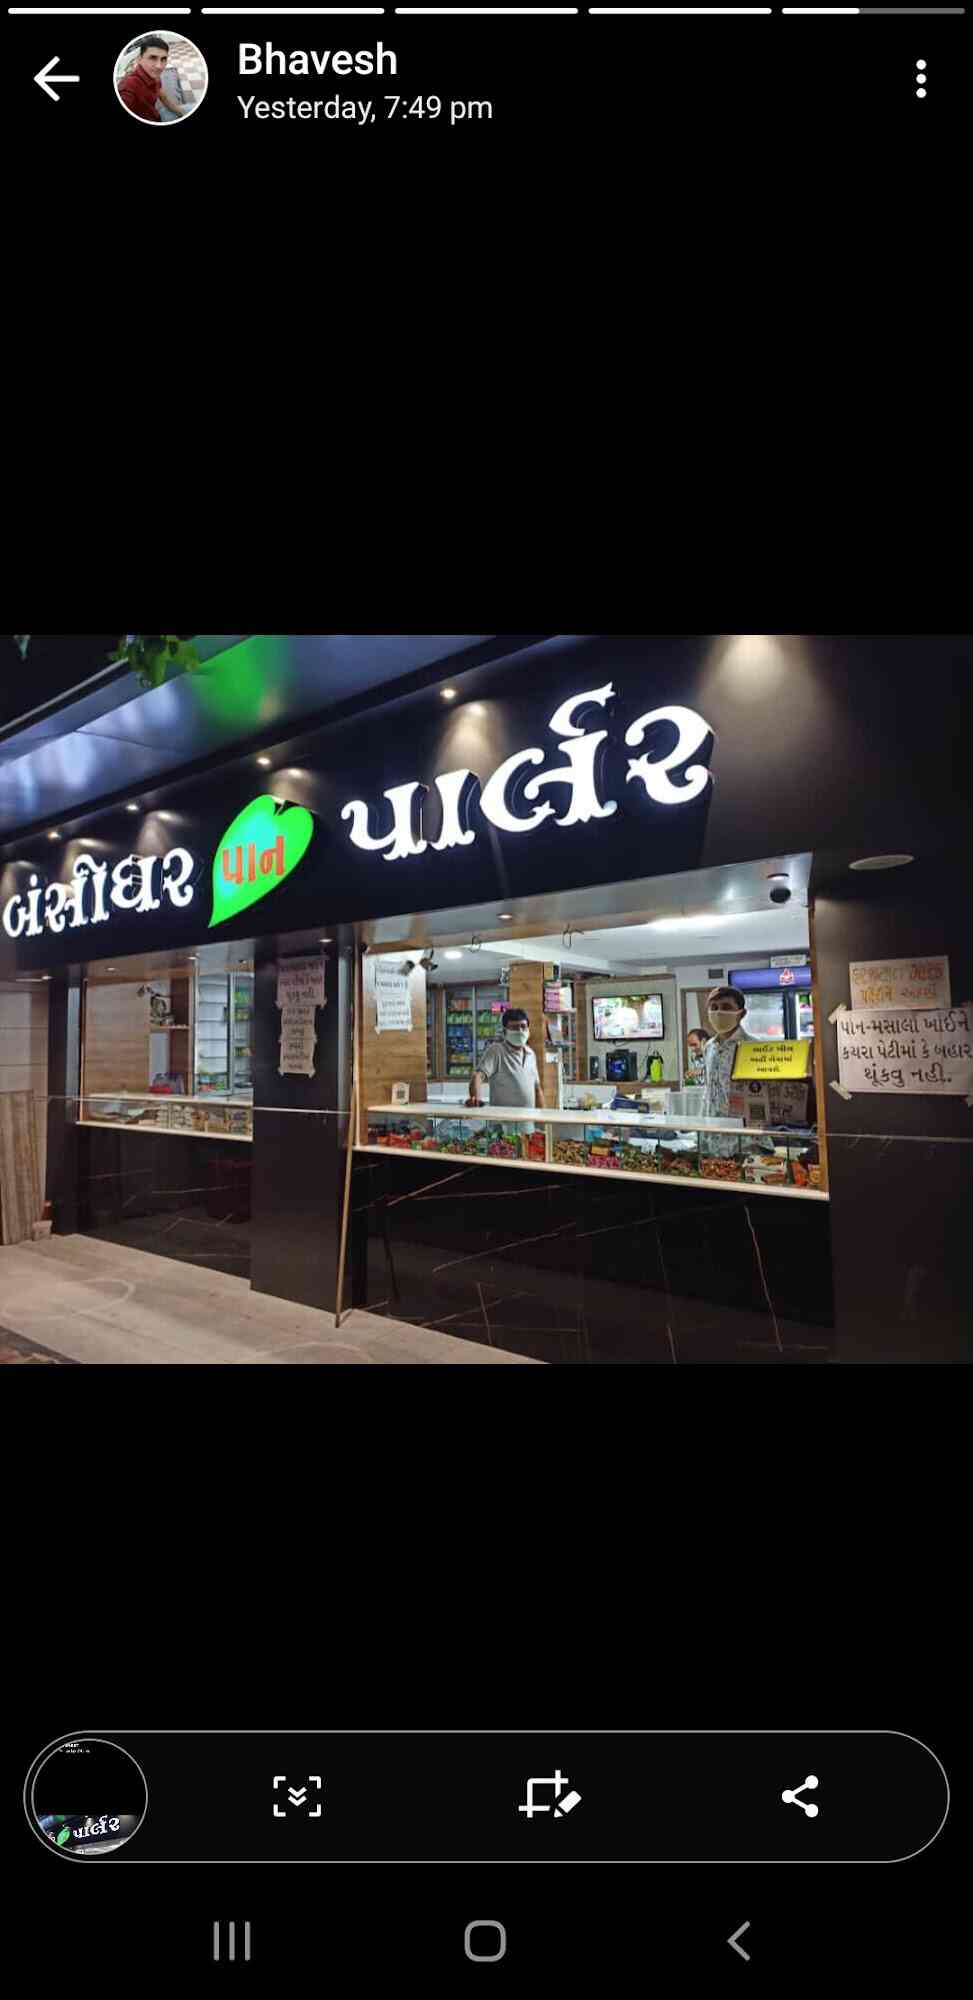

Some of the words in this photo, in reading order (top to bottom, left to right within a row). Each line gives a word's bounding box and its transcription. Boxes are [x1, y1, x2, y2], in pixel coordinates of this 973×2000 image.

[222, 835, 285, 885] પાન
[341, 682, 714, 861] પાર્લર
[923, 1010, 970, 1033] ખાઈને
[842, 1045, 874, 1060] કચરા
[877, 1039, 917, 1059] પેટીમાં
[921, 1038, 930, 1059] કે
[934, 1043, 973, 1059] બહાર
